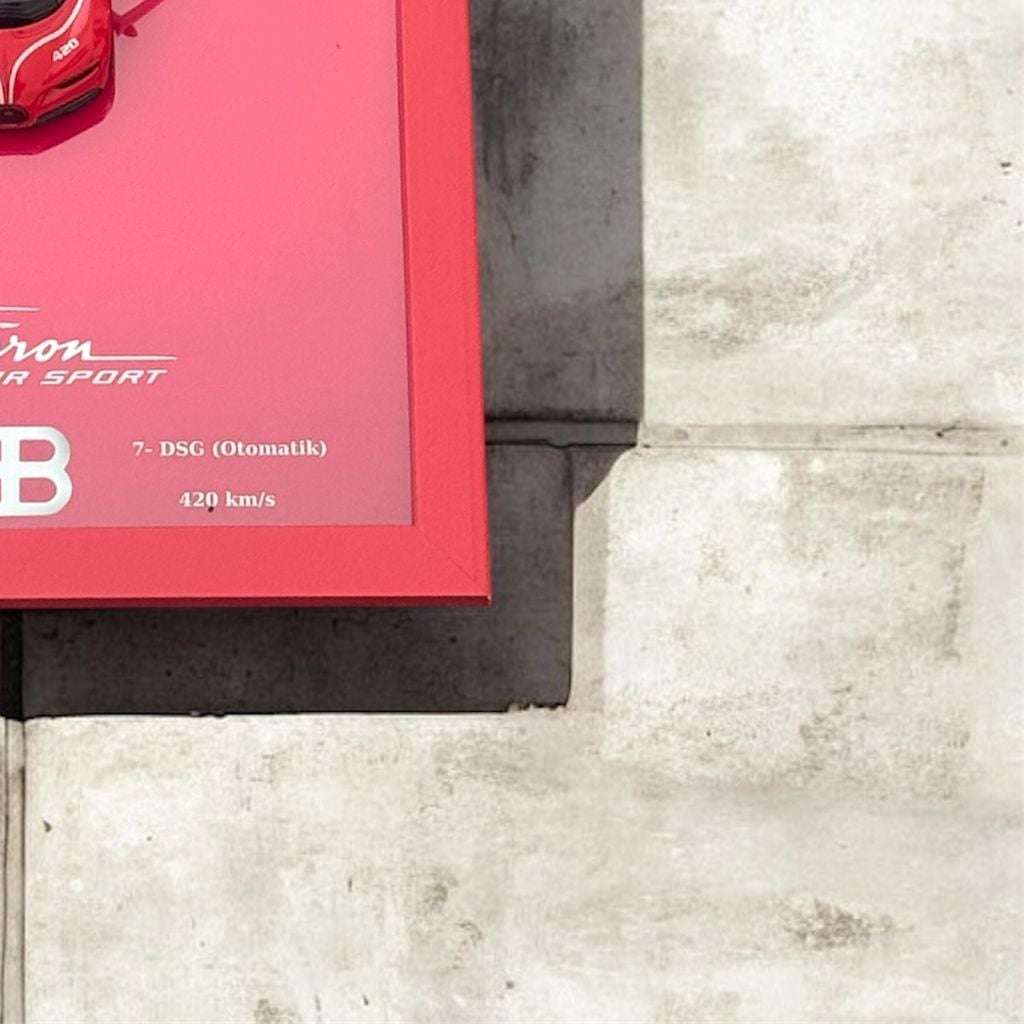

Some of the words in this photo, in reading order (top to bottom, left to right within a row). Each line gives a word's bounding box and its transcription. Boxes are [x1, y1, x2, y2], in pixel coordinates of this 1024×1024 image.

[52, 37, 80, 62] 420
[39, 368, 168, 386] SPORT
[132, 441, 153, 456] 7-
[160, 441, 205, 456] DSG
[212, 440, 327, 458] (Otomatik)
[179, 491, 219, 507] 420
[226, 491, 276, 507] km/s
